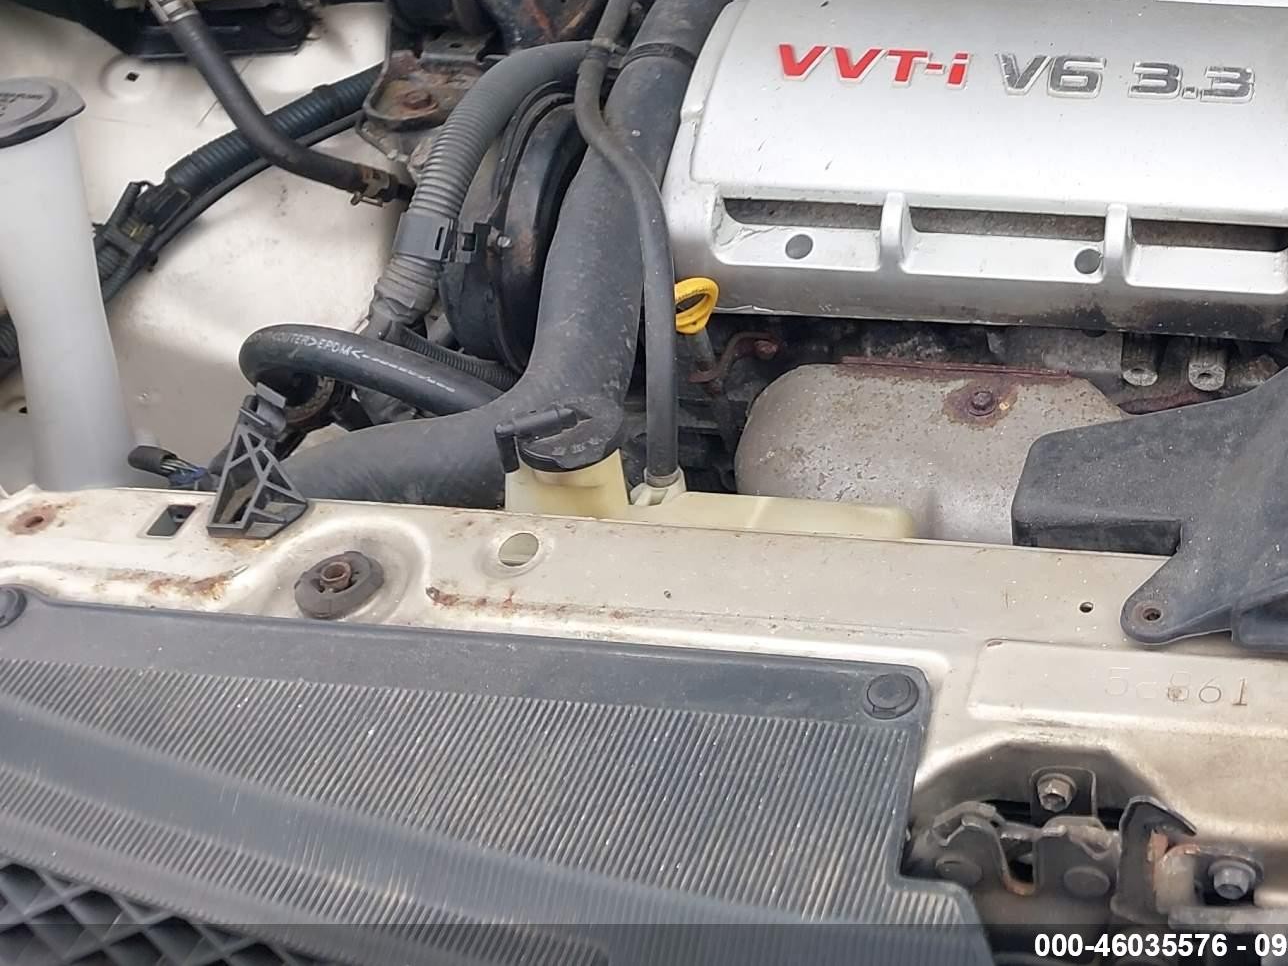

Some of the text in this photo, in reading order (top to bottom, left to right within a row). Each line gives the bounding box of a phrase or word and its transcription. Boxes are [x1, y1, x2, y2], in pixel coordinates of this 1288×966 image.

[778, 42, 1257, 105] VVT-i V6 3.3
